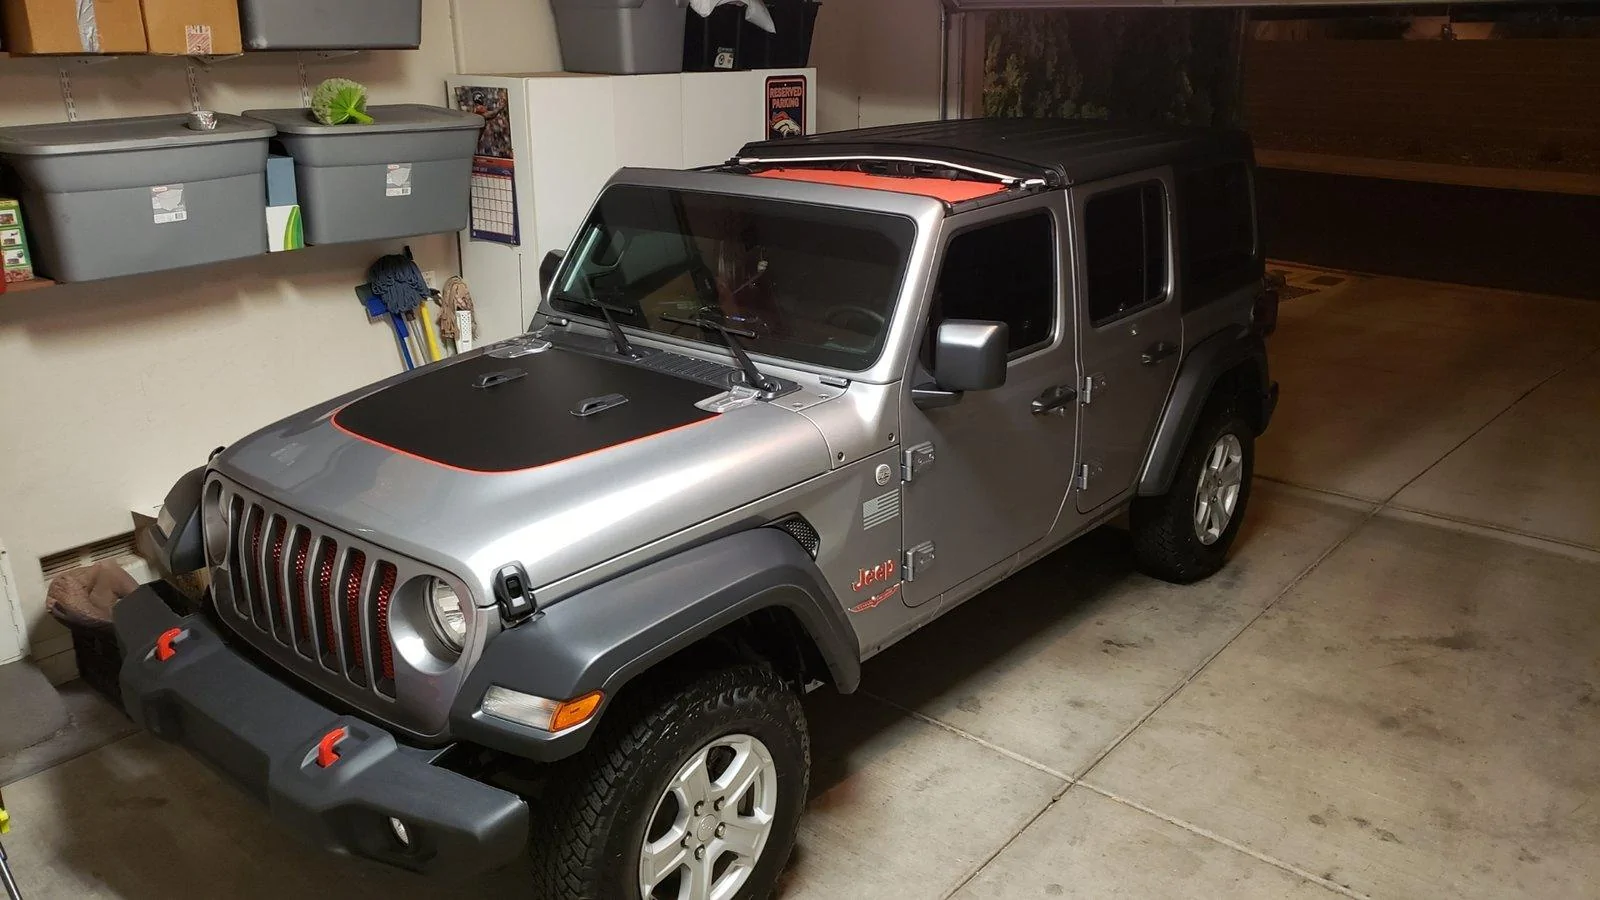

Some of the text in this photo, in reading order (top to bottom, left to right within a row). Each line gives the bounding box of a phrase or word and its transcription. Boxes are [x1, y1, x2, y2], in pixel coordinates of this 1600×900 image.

[769, 86, 802, 98] RESERVED
[772, 97, 800, 108] PARKING
[851, 559, 895, 592] Jeep
